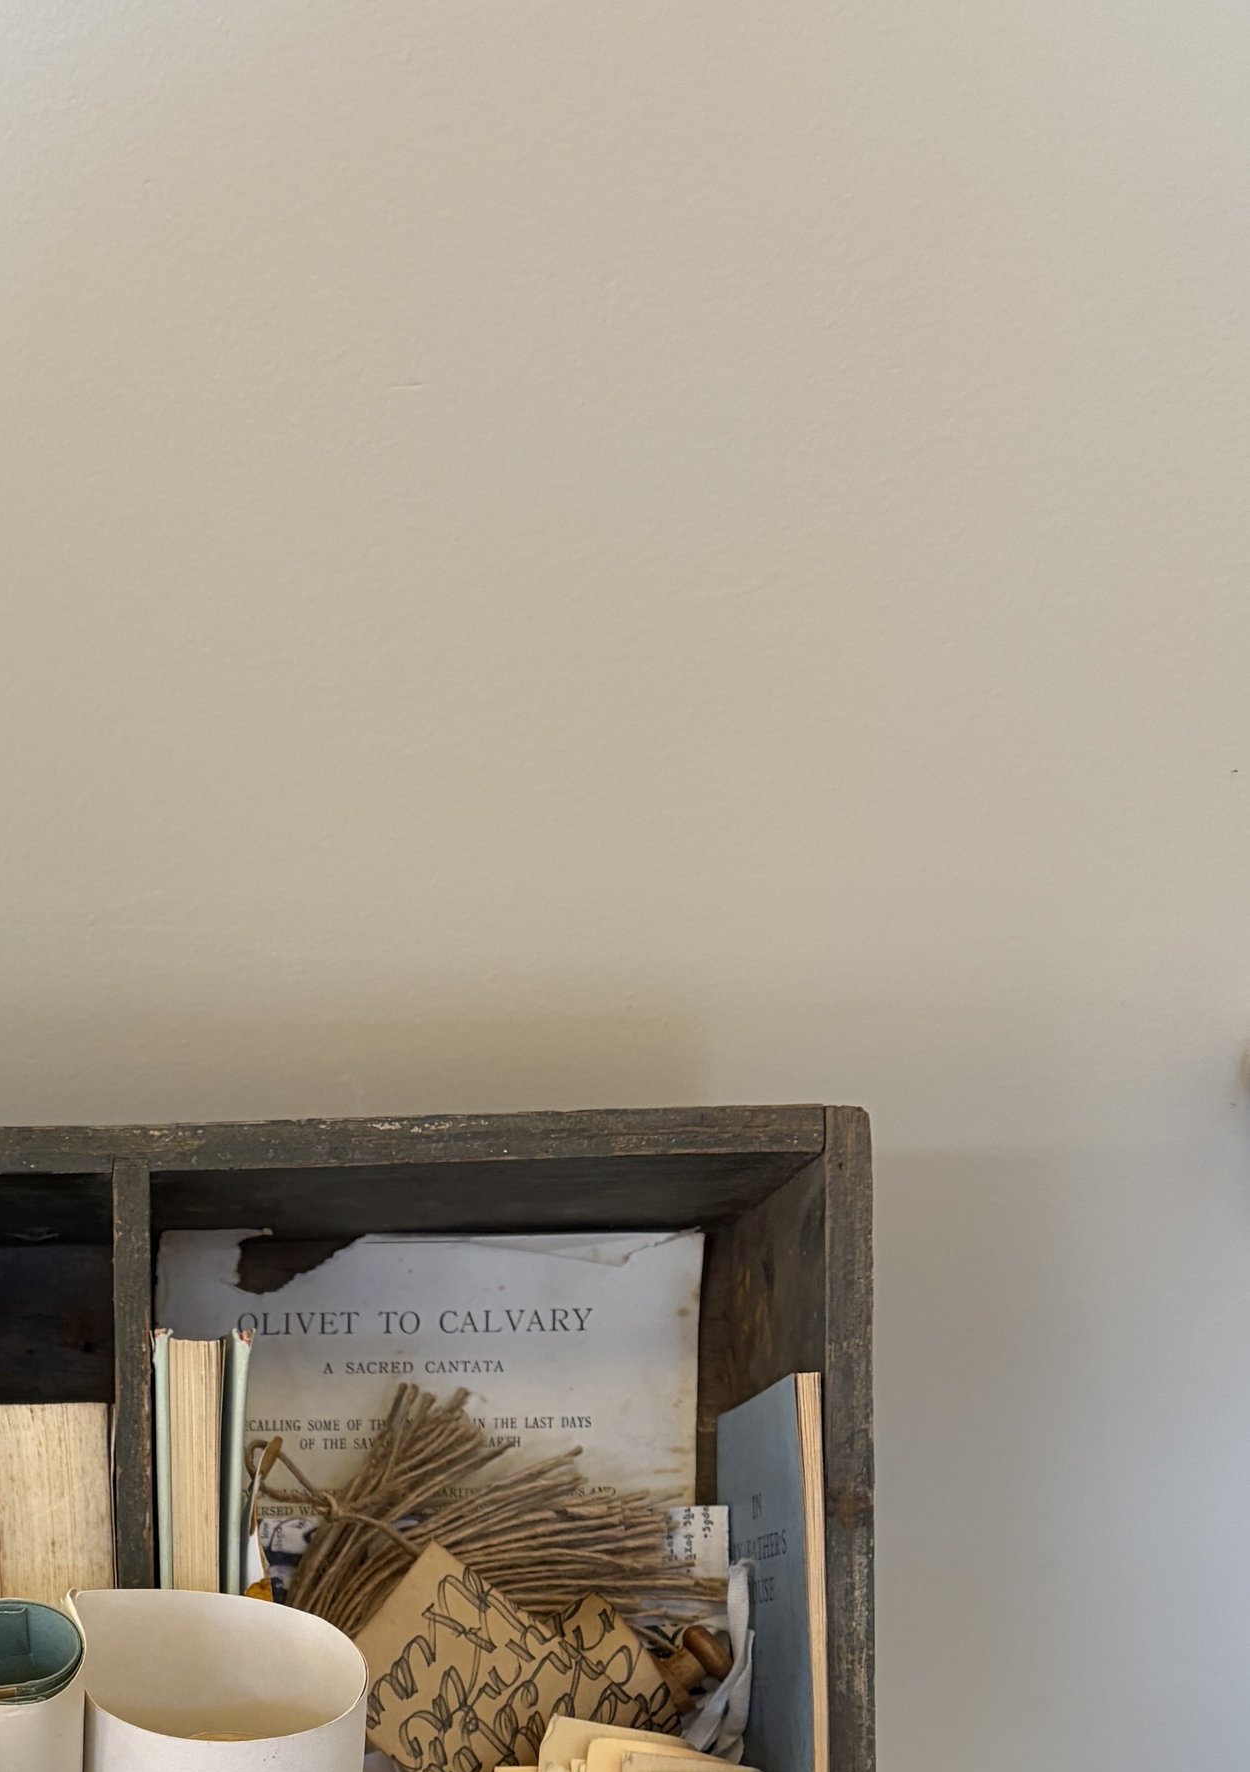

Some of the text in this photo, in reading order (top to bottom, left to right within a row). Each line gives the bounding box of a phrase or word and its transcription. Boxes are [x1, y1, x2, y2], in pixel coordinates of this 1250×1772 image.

[237, 1308, 593, 1336] OLIVET TO CALVARY
[323, 1360, 504, 1374] A SACRED CANTATA
[307, 1419, 362, 1431] SOME OF
[494, 1417, 517, 1429] THE
[524, 1417, 554, 1429] LAST
[561, 1416, 592, 1428] DAYS
[300, 1438, 346, 1450] OF THE
